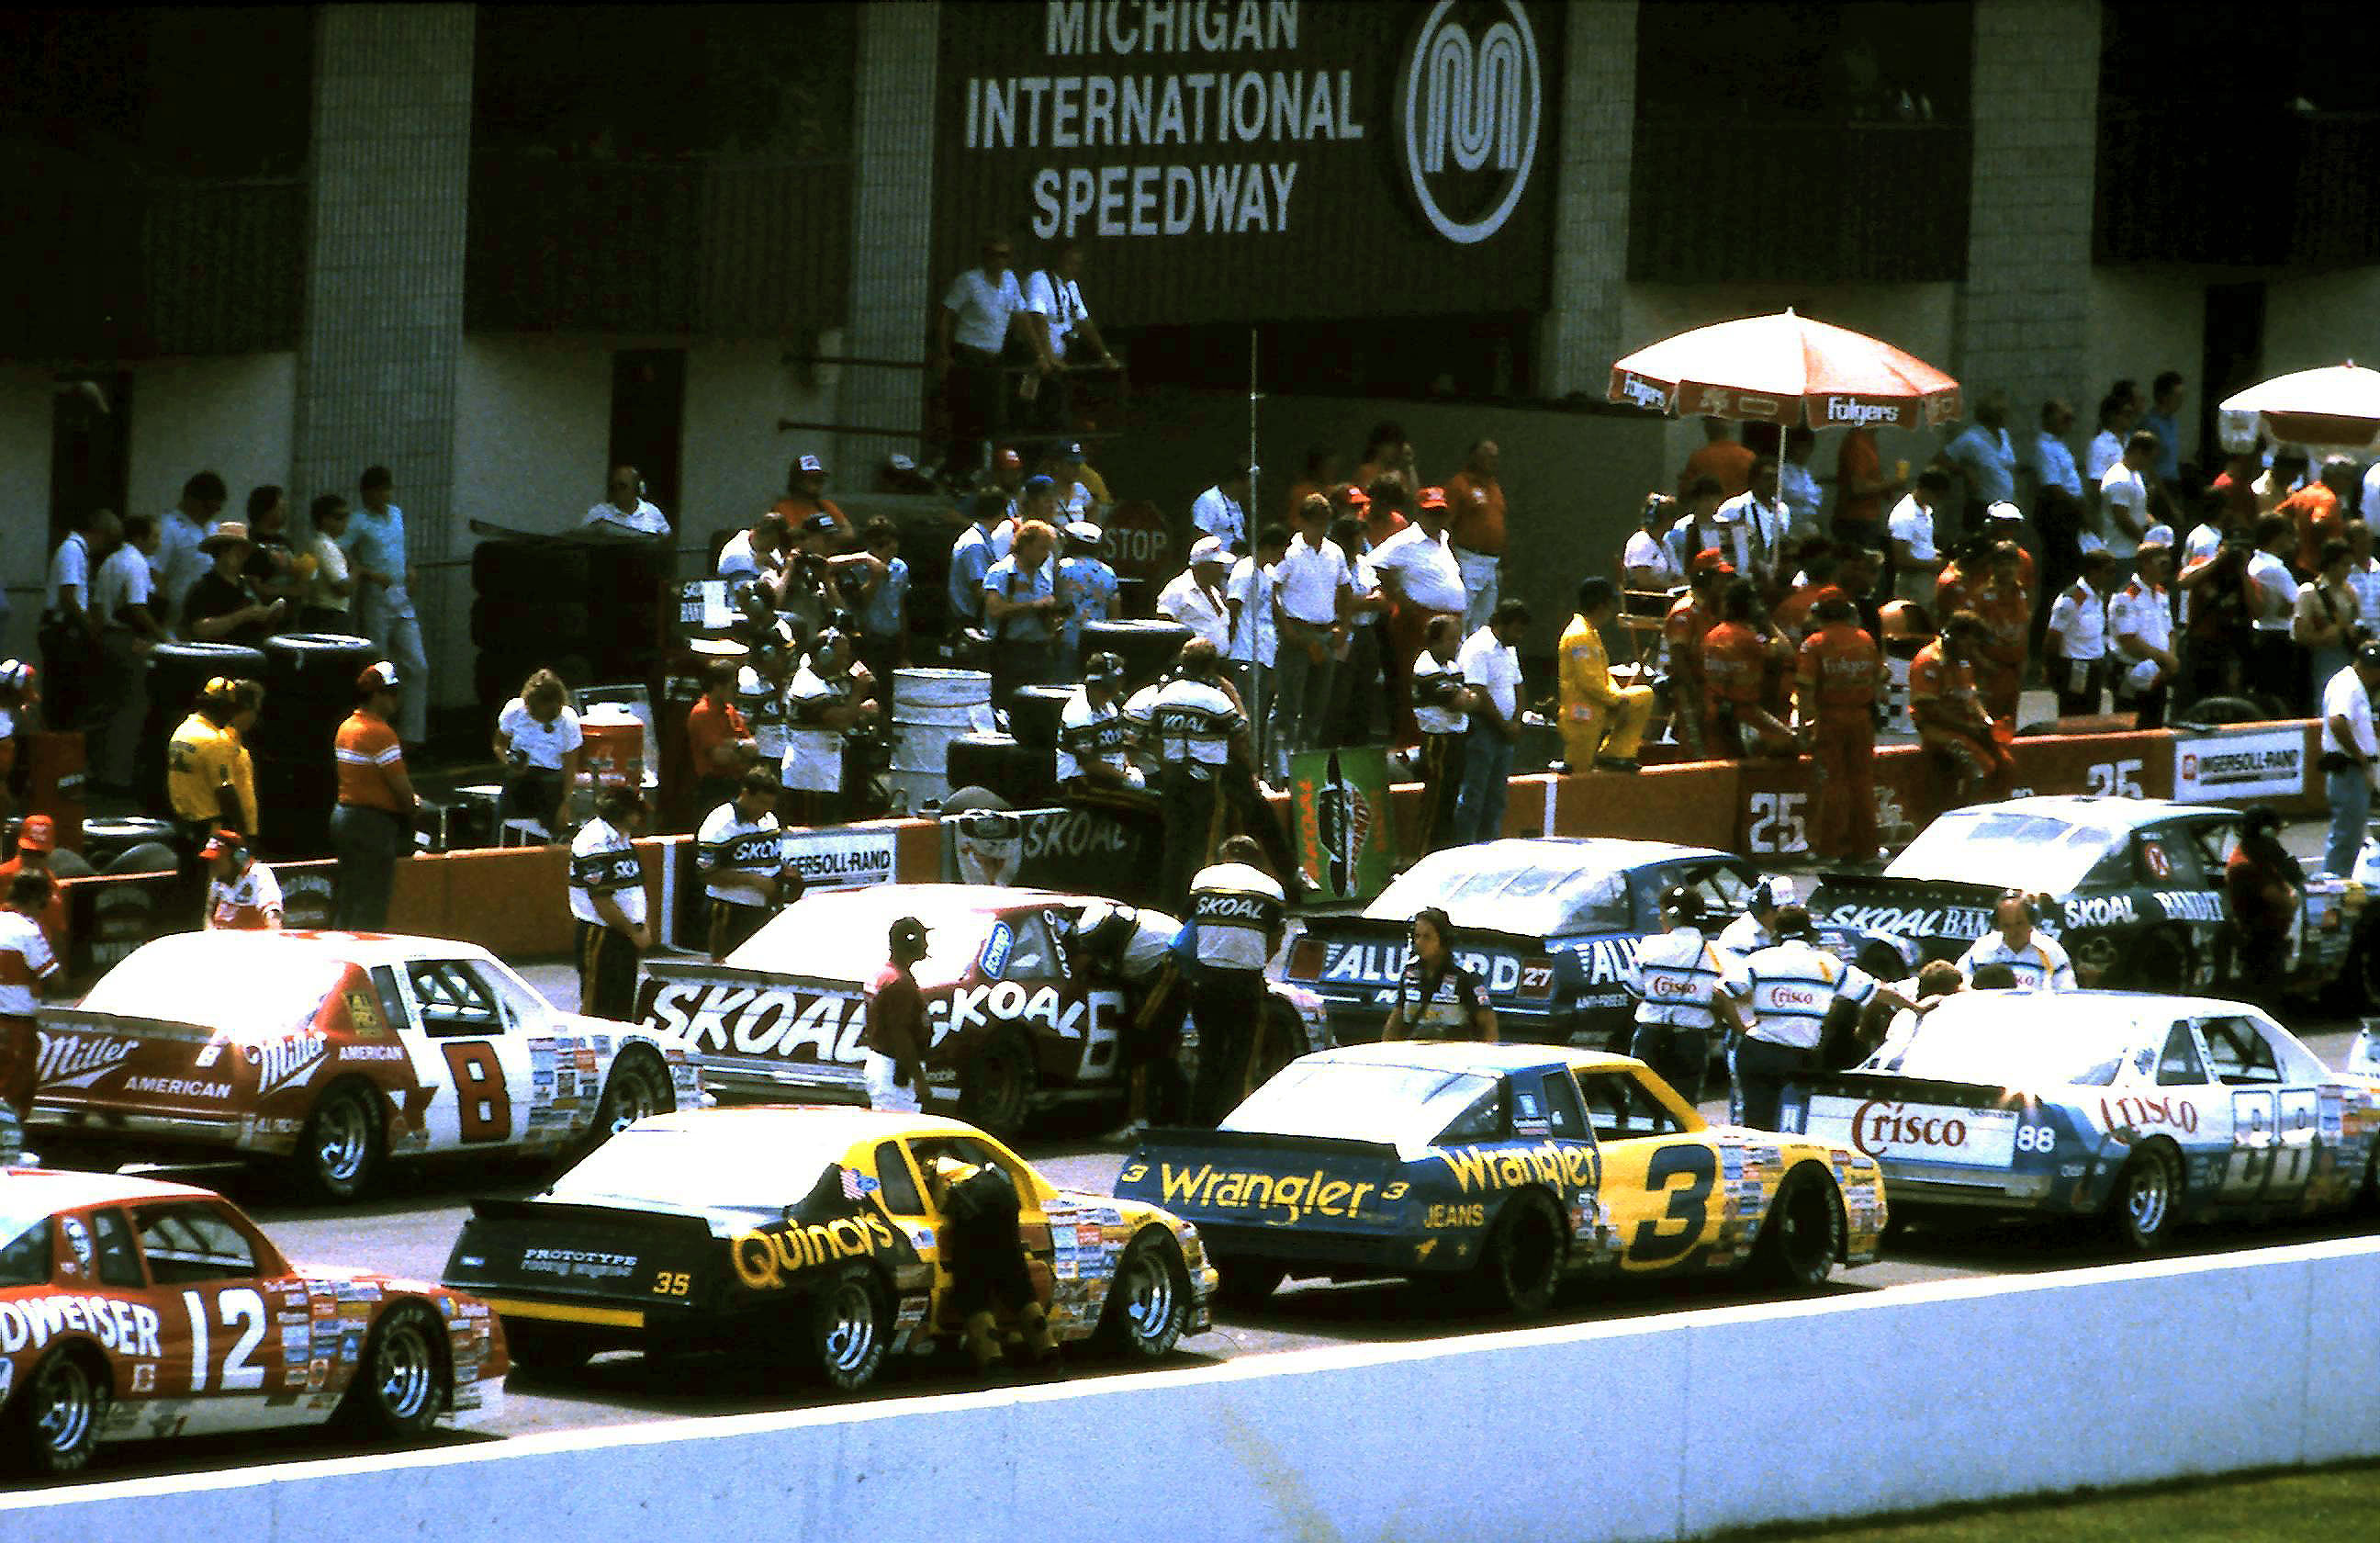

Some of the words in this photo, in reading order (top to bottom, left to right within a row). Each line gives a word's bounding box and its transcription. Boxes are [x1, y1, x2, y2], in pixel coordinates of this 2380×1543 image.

[1046, 0, 1299, 55] MICHIGAN
[965, 70, 1365, 149] INTERNATIONAL
[1031, 163, 1297, 240] SPEEDWAY
[1827, 395, 1899, 427] Folgers
[1103, 528, 1168, 561] STOP
[2087, 758, 2144, 800] 25
[1024, 810, 1128, 858] SKOAL
[1749, 792, 1809, 853] 25
[1196, 895, 1263, 919] SKOAL
[1831, 904, 1944, 938] SKOAL
[2063, 895, 2140, 930] SKOAL
[1523, 967, 1553, 986] 27
[1770, 985, 1813, 1008] Crisco
[644, 983, 875, 1064] SKOAL
[37, 1030, 140, 1084] Miller
[244, 1030, 328, 1095] Miller
[339, 1044, 405, 1061] AMERICAN
[123, 1075, 232, 1099] AMERICAN
[441, 1040, 511, 1143] 8
[1851, 1098, 1967, 1155] Crisco
[2016, 1124, 2056, 1154] 88
[1431, 1140, 1597, 1200] Wrangler
[1121, 1165, 1149, 1183] 3
[1161, 1162, 1375, 1227] Wrangler
[1380, 1181, 1411, 1201] 3
[1424, 1203, 1485, 1229] JEANS
[1627, 1144, 1716, 1263] 3
[524, 1248, 640, 1267] PROTOTYPE
[652, 1269, 691, 1297] 35
[183, 1289, 266, 1392] 12
